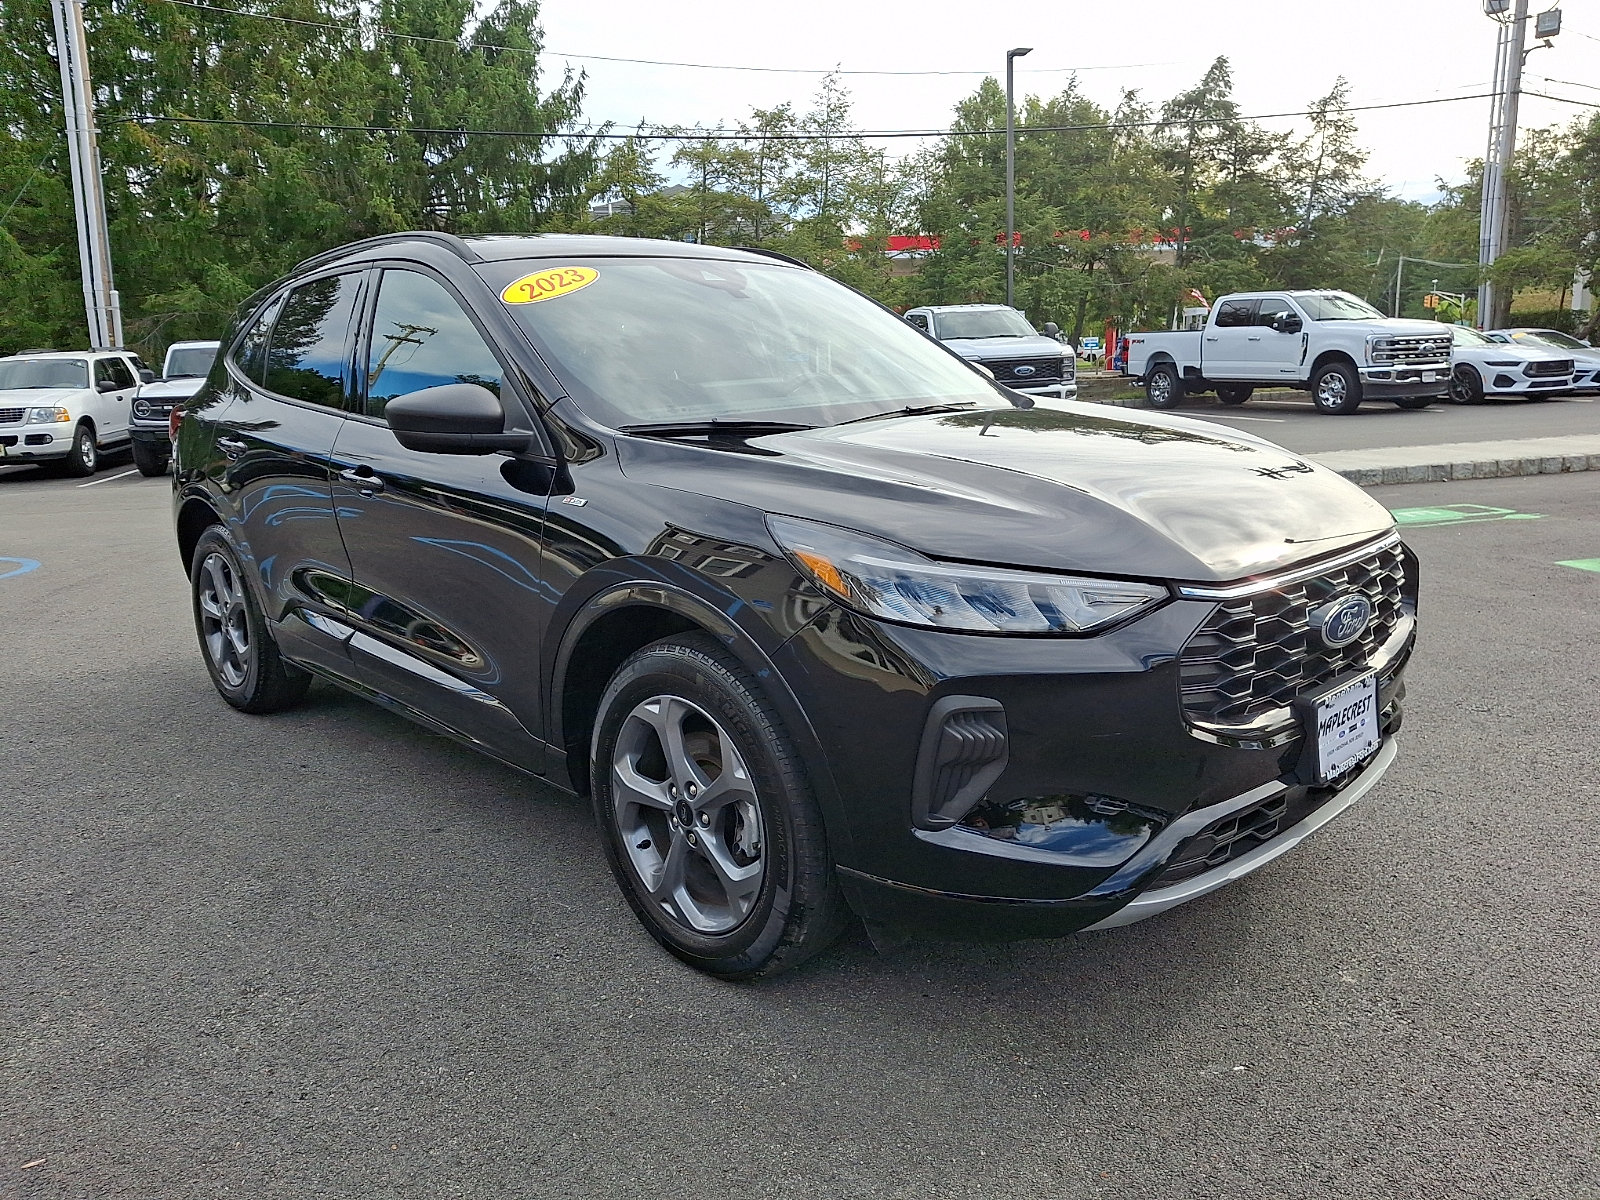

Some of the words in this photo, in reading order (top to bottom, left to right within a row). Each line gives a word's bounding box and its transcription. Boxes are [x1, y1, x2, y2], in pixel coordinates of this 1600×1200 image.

[519, 269, 585, 300] 2023
[1337, 606, 1365, 638] Ford
[1318, 693, 1373, 737] MAPLECREST
